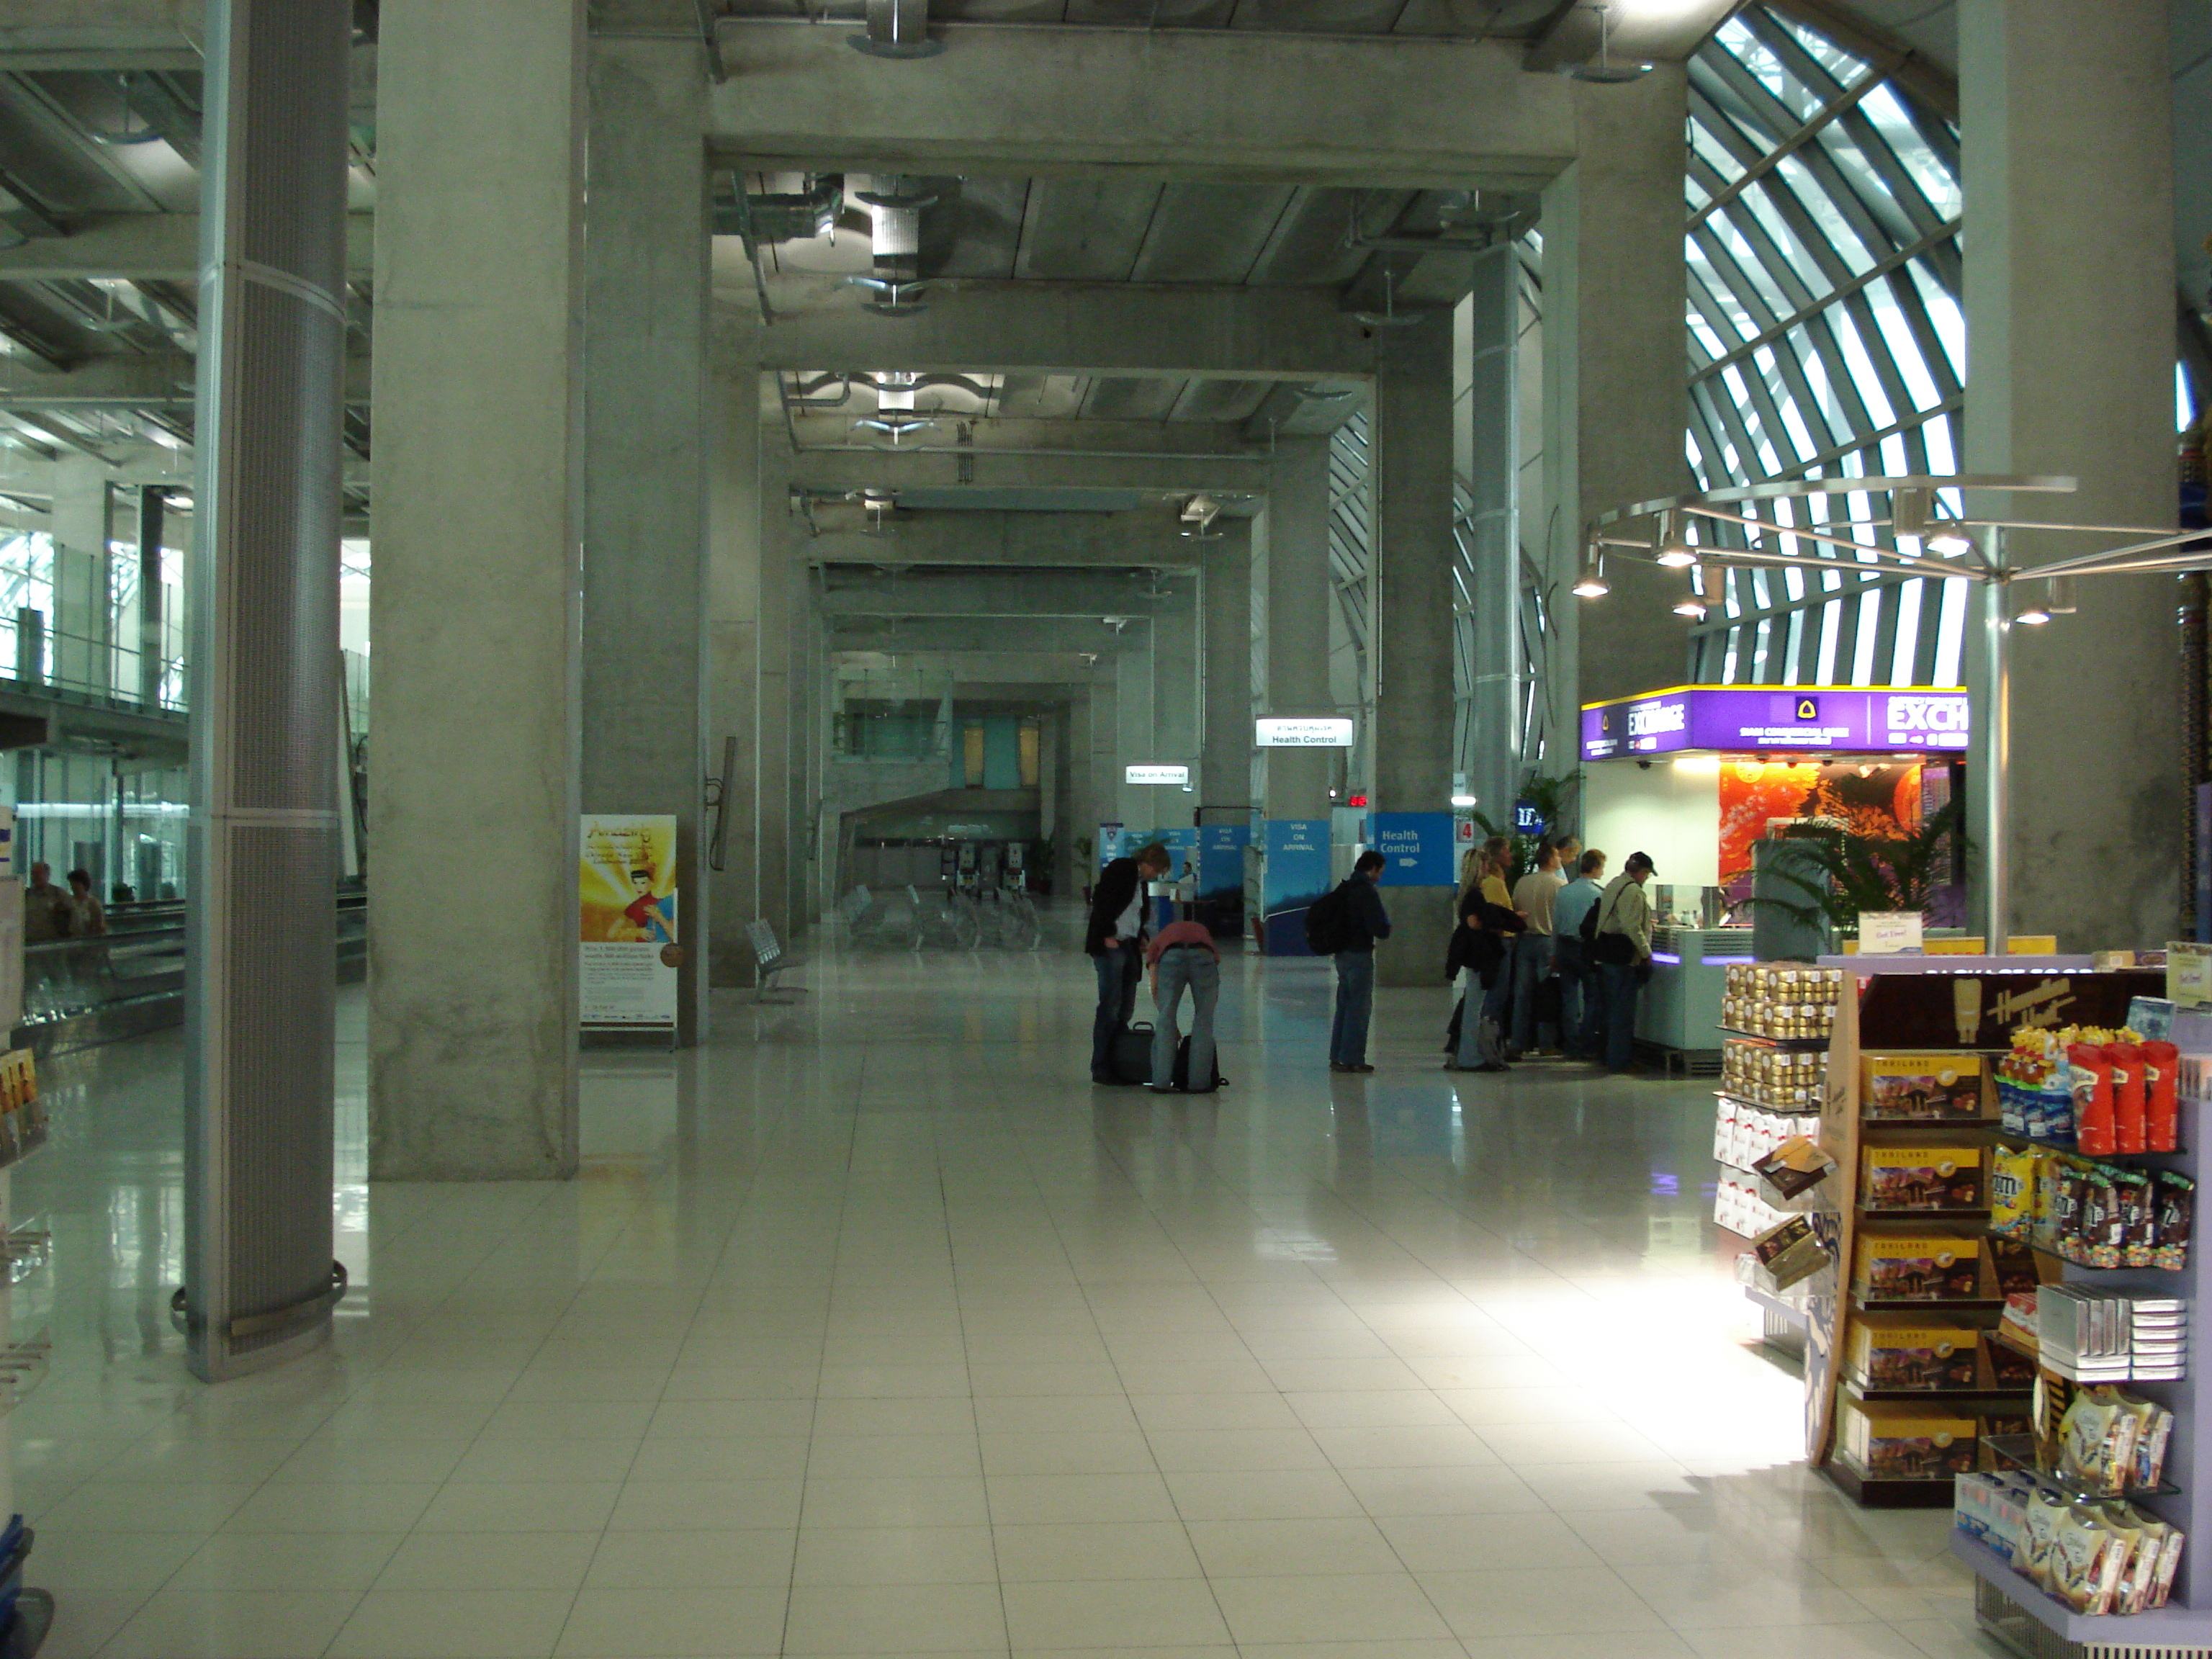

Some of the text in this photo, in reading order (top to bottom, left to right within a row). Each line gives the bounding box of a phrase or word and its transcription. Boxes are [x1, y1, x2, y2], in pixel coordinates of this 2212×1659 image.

[1272, 735, 1336, 744] Health Control
[1382, 830, 1419, 841] Health
[1380, 842, 1421, 853] Control
